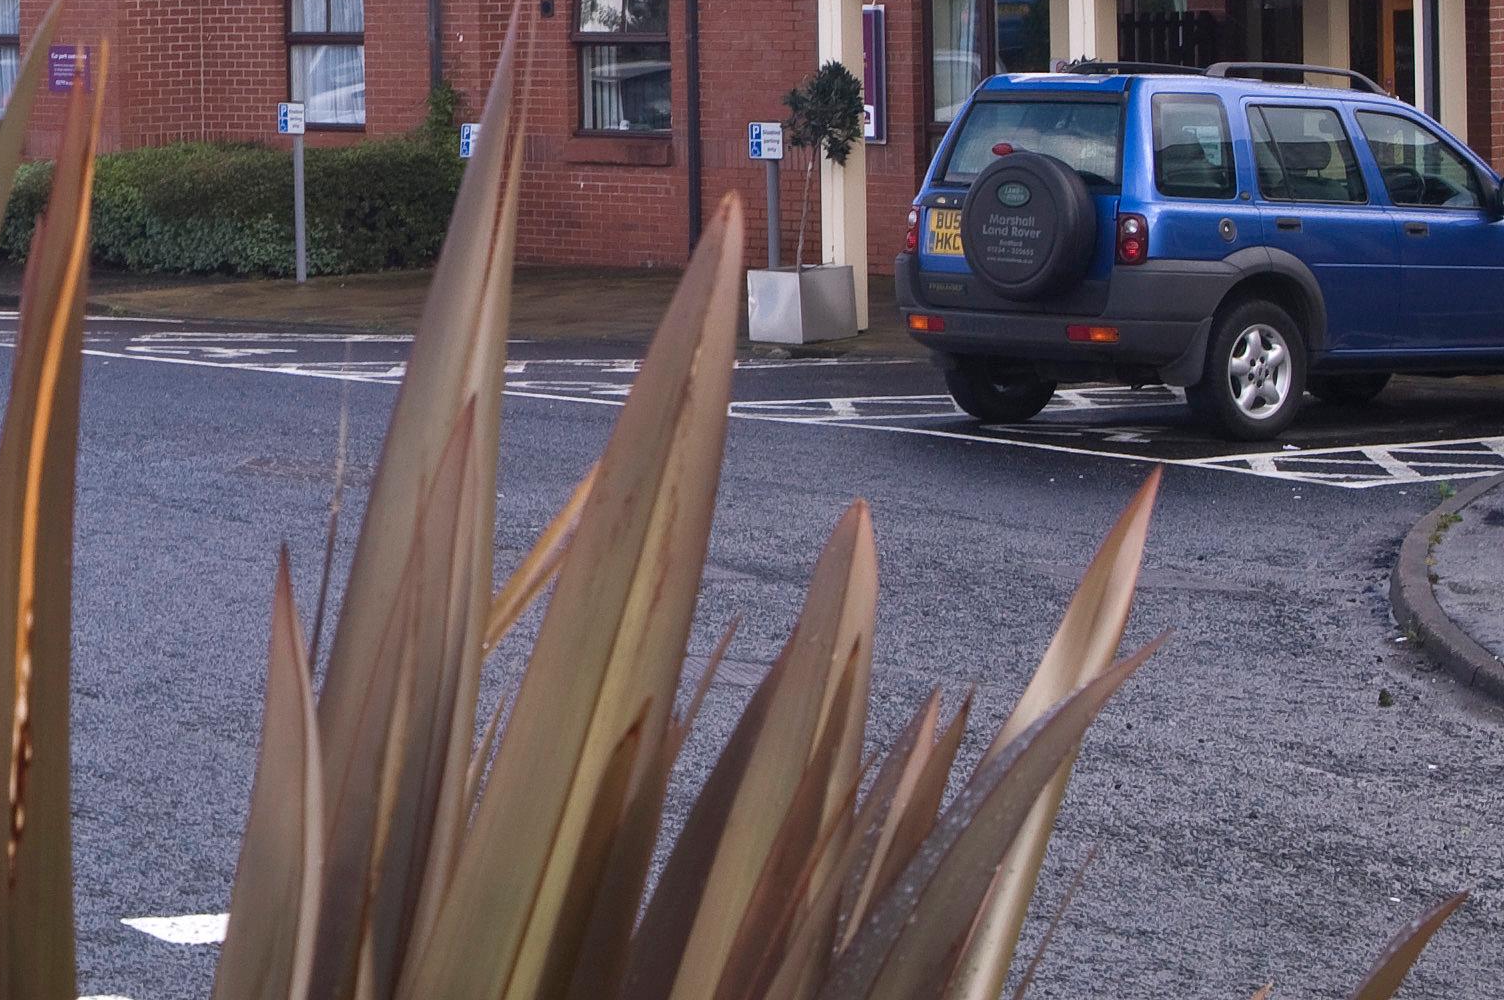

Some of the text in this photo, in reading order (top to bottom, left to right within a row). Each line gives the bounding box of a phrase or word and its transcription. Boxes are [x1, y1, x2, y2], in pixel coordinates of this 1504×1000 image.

[752, 124, 760, 139] P
[937, 212, 961, 229] BU5
[989, 213, 1035, 227] Marshall
[982, 224, 1042, 239] Land Rover
